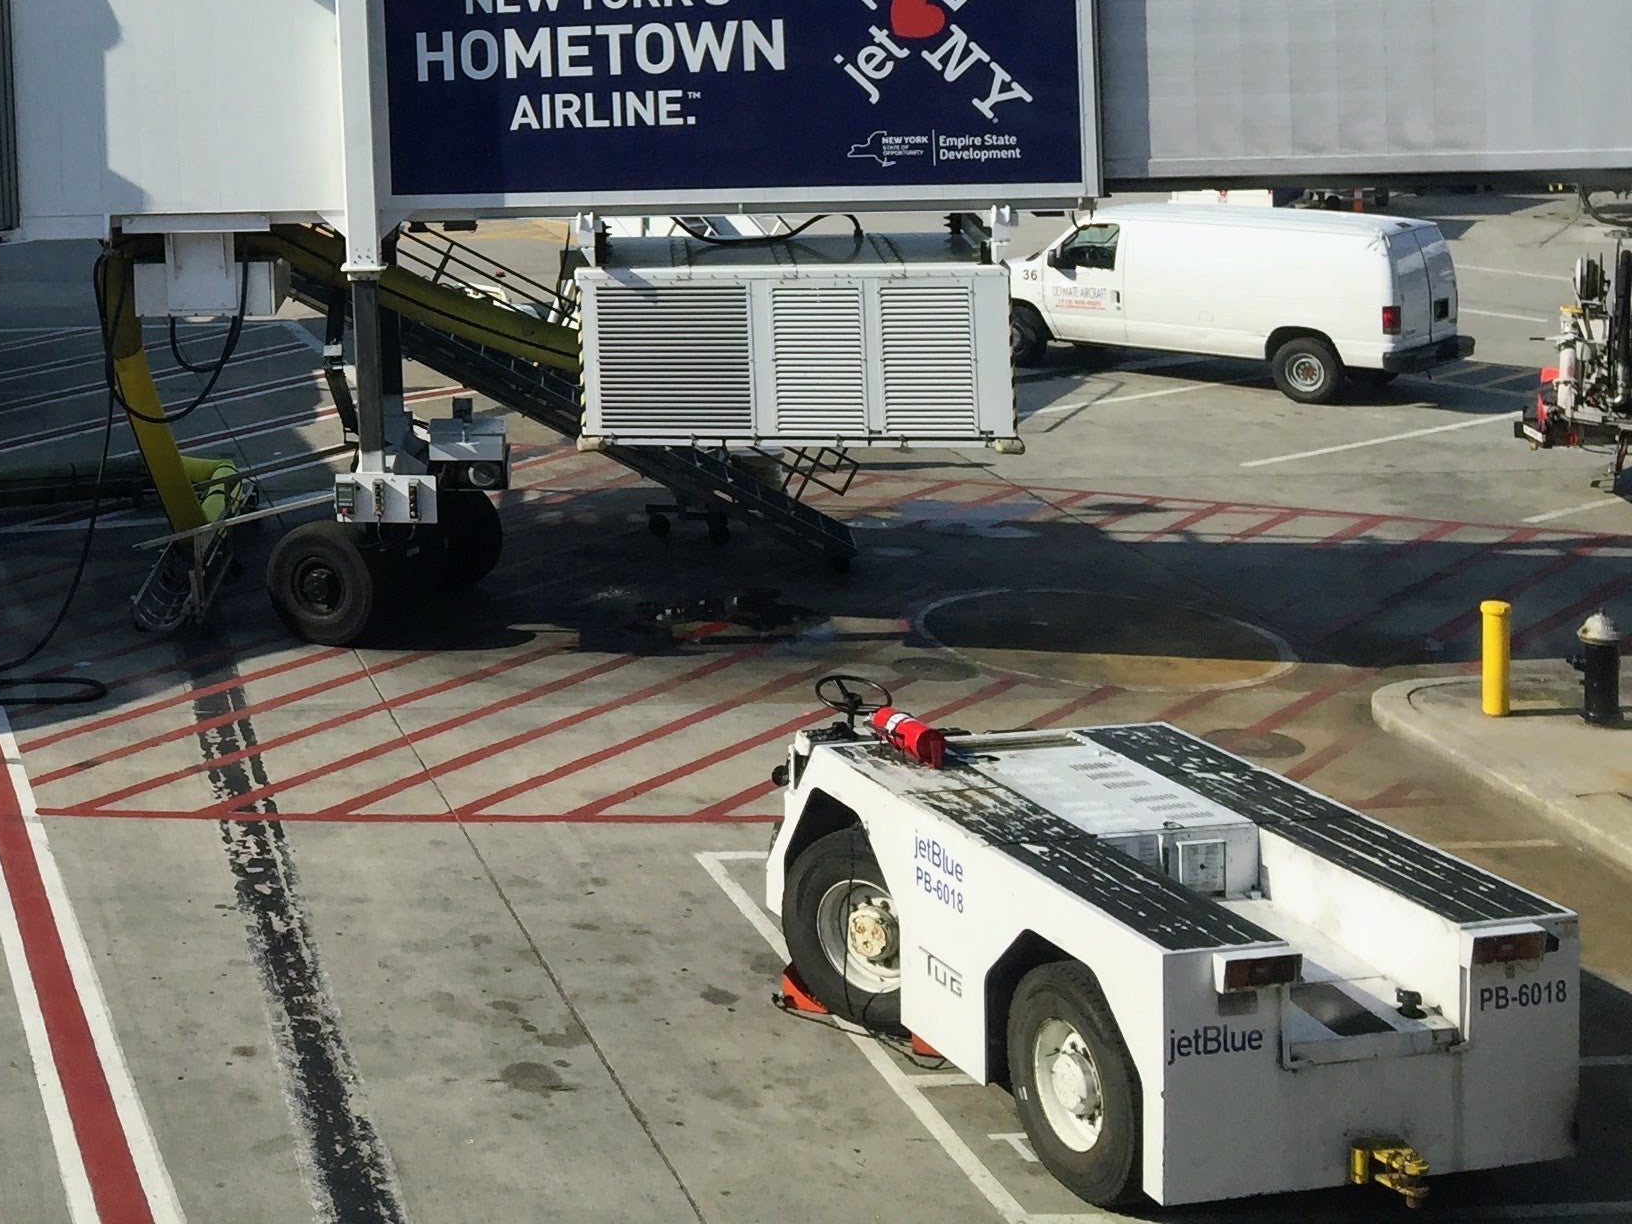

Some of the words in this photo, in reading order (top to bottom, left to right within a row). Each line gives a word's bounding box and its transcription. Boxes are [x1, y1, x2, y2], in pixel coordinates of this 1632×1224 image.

[416, 19, 786, 82] HOMETOWN
[881, 136, 903, 145] NEW
[903, 135, 929, 144] YORK
[938, 135, 982, 150] Empire
[983, 133, 1018, 146] State
[939, 147, 1022, 163] Development
[1023, 269, 1038, 281] 36
[914, 829, 964, 883] jetBlue
[916, 866, 964, 914] PB-6018
[919, 945, 963, 998] TUG
[1480, 979, 1567, 1012] PB-6018
[1167, 1025, 1264, 1066] jetBlue
